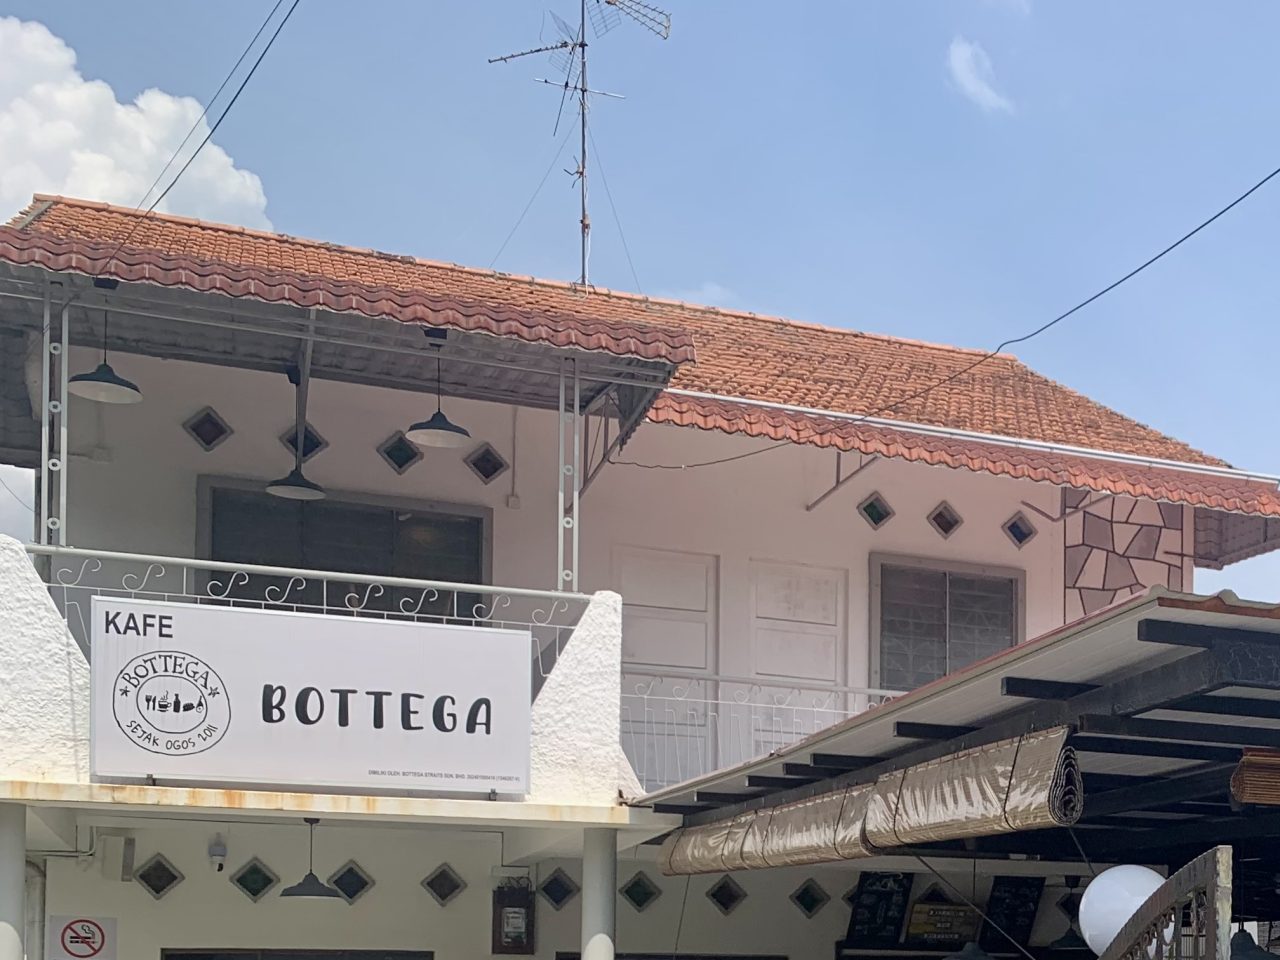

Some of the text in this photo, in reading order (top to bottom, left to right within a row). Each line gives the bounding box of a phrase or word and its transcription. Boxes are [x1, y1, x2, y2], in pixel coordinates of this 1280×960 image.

[104, 610, 173, 639] KAFE
[122, 654, 211, 690] BOTTEGA
[261, 683, 492, 735] BOTTEGA
[126, 720, 219, 750] SEJAK OGOS 2011
